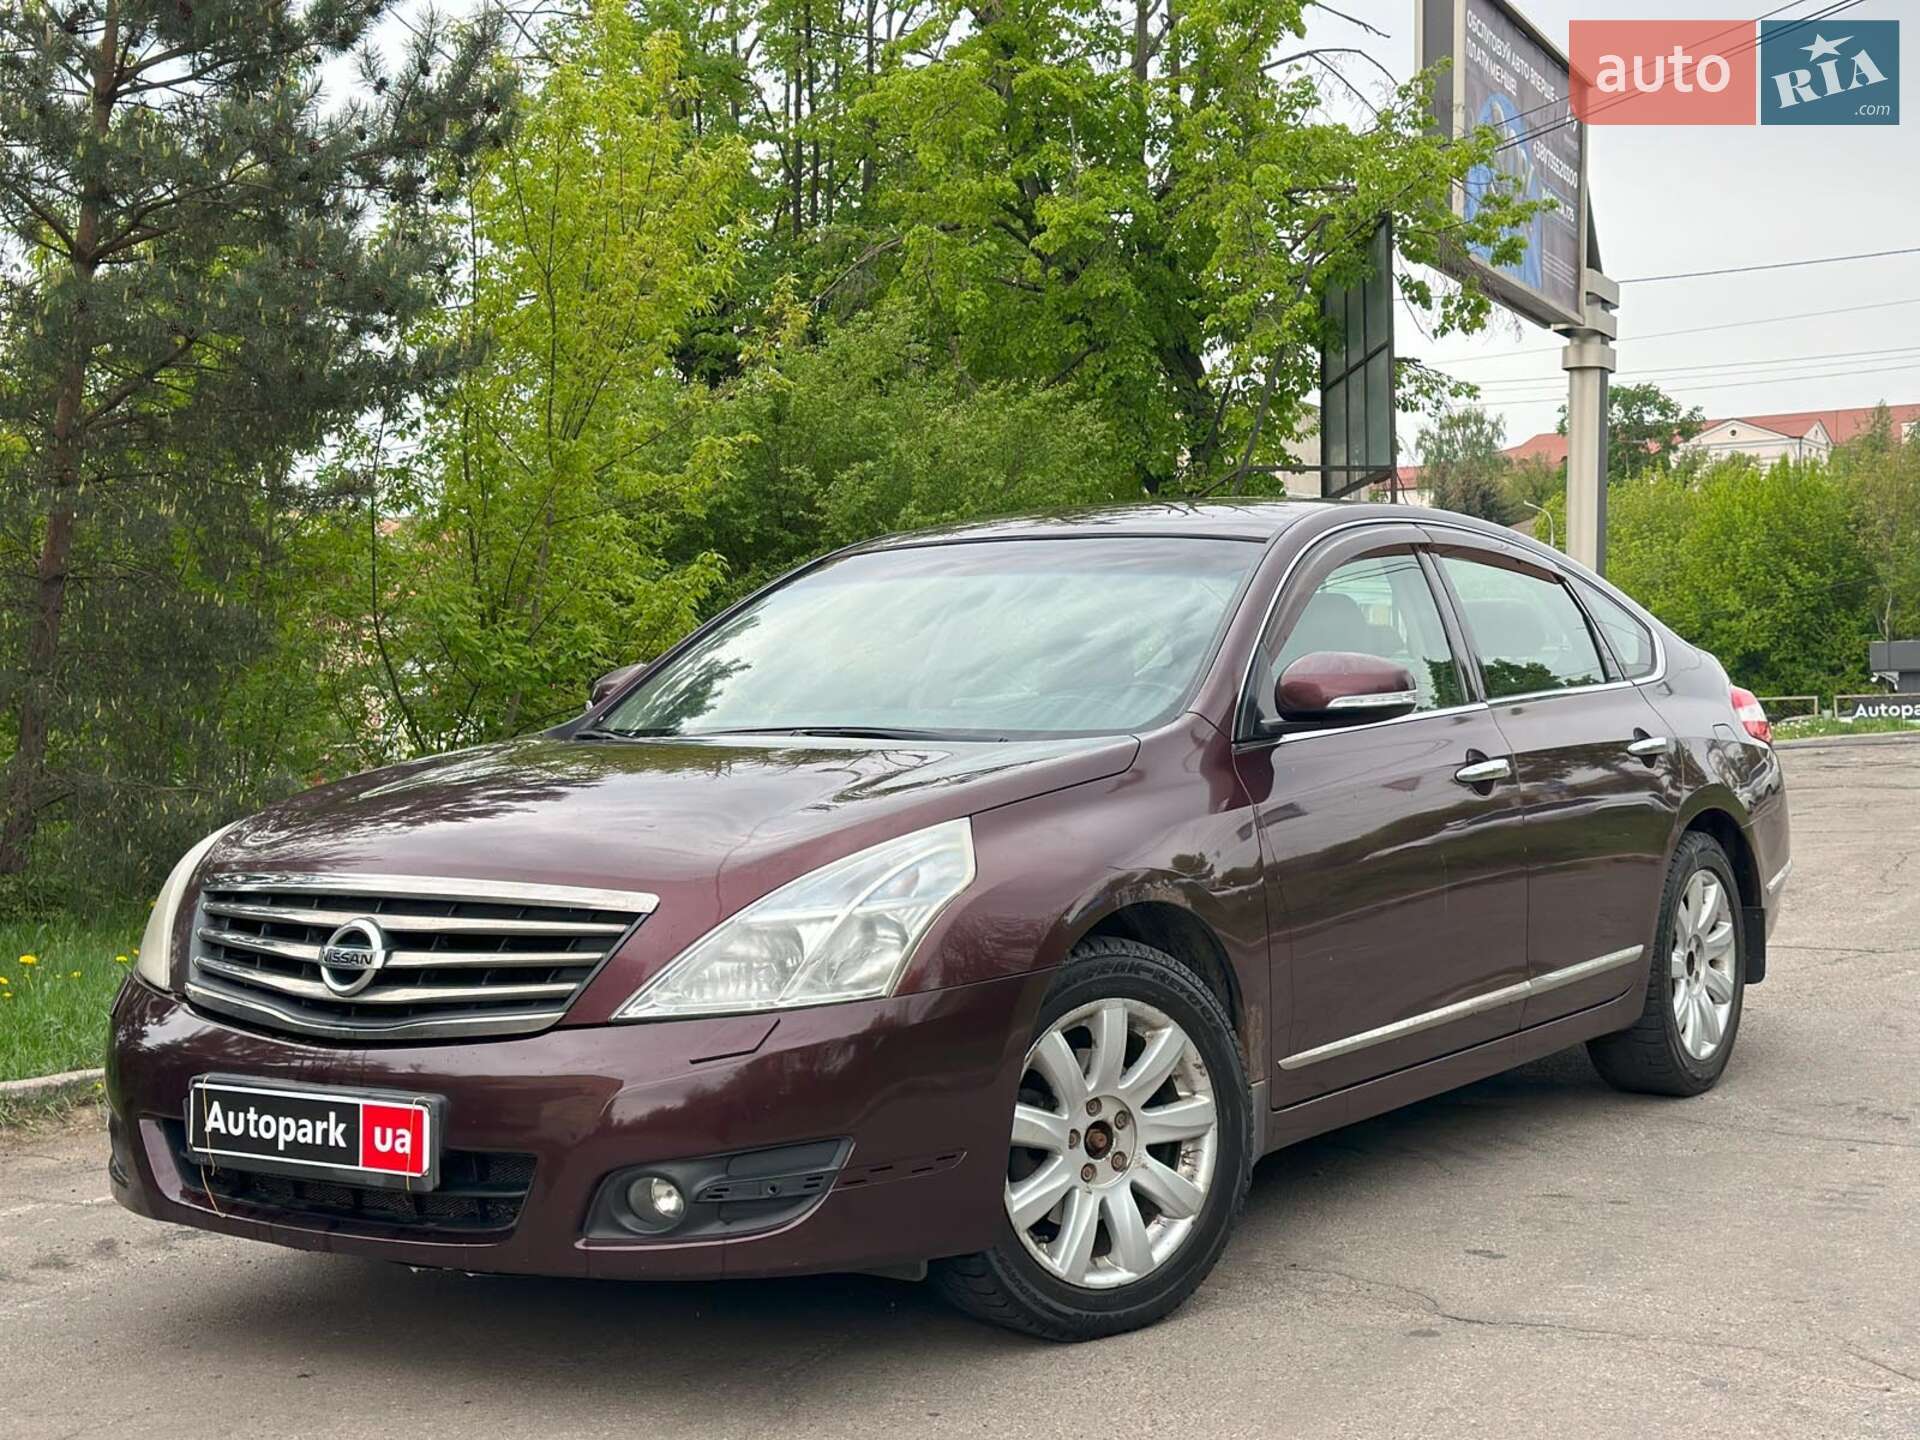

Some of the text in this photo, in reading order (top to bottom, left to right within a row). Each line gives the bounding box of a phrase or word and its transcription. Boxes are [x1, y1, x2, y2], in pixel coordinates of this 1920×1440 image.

[323, 949, 373, 965] NISSAN
[205, 1101, 411, 1154] Autopark ua
